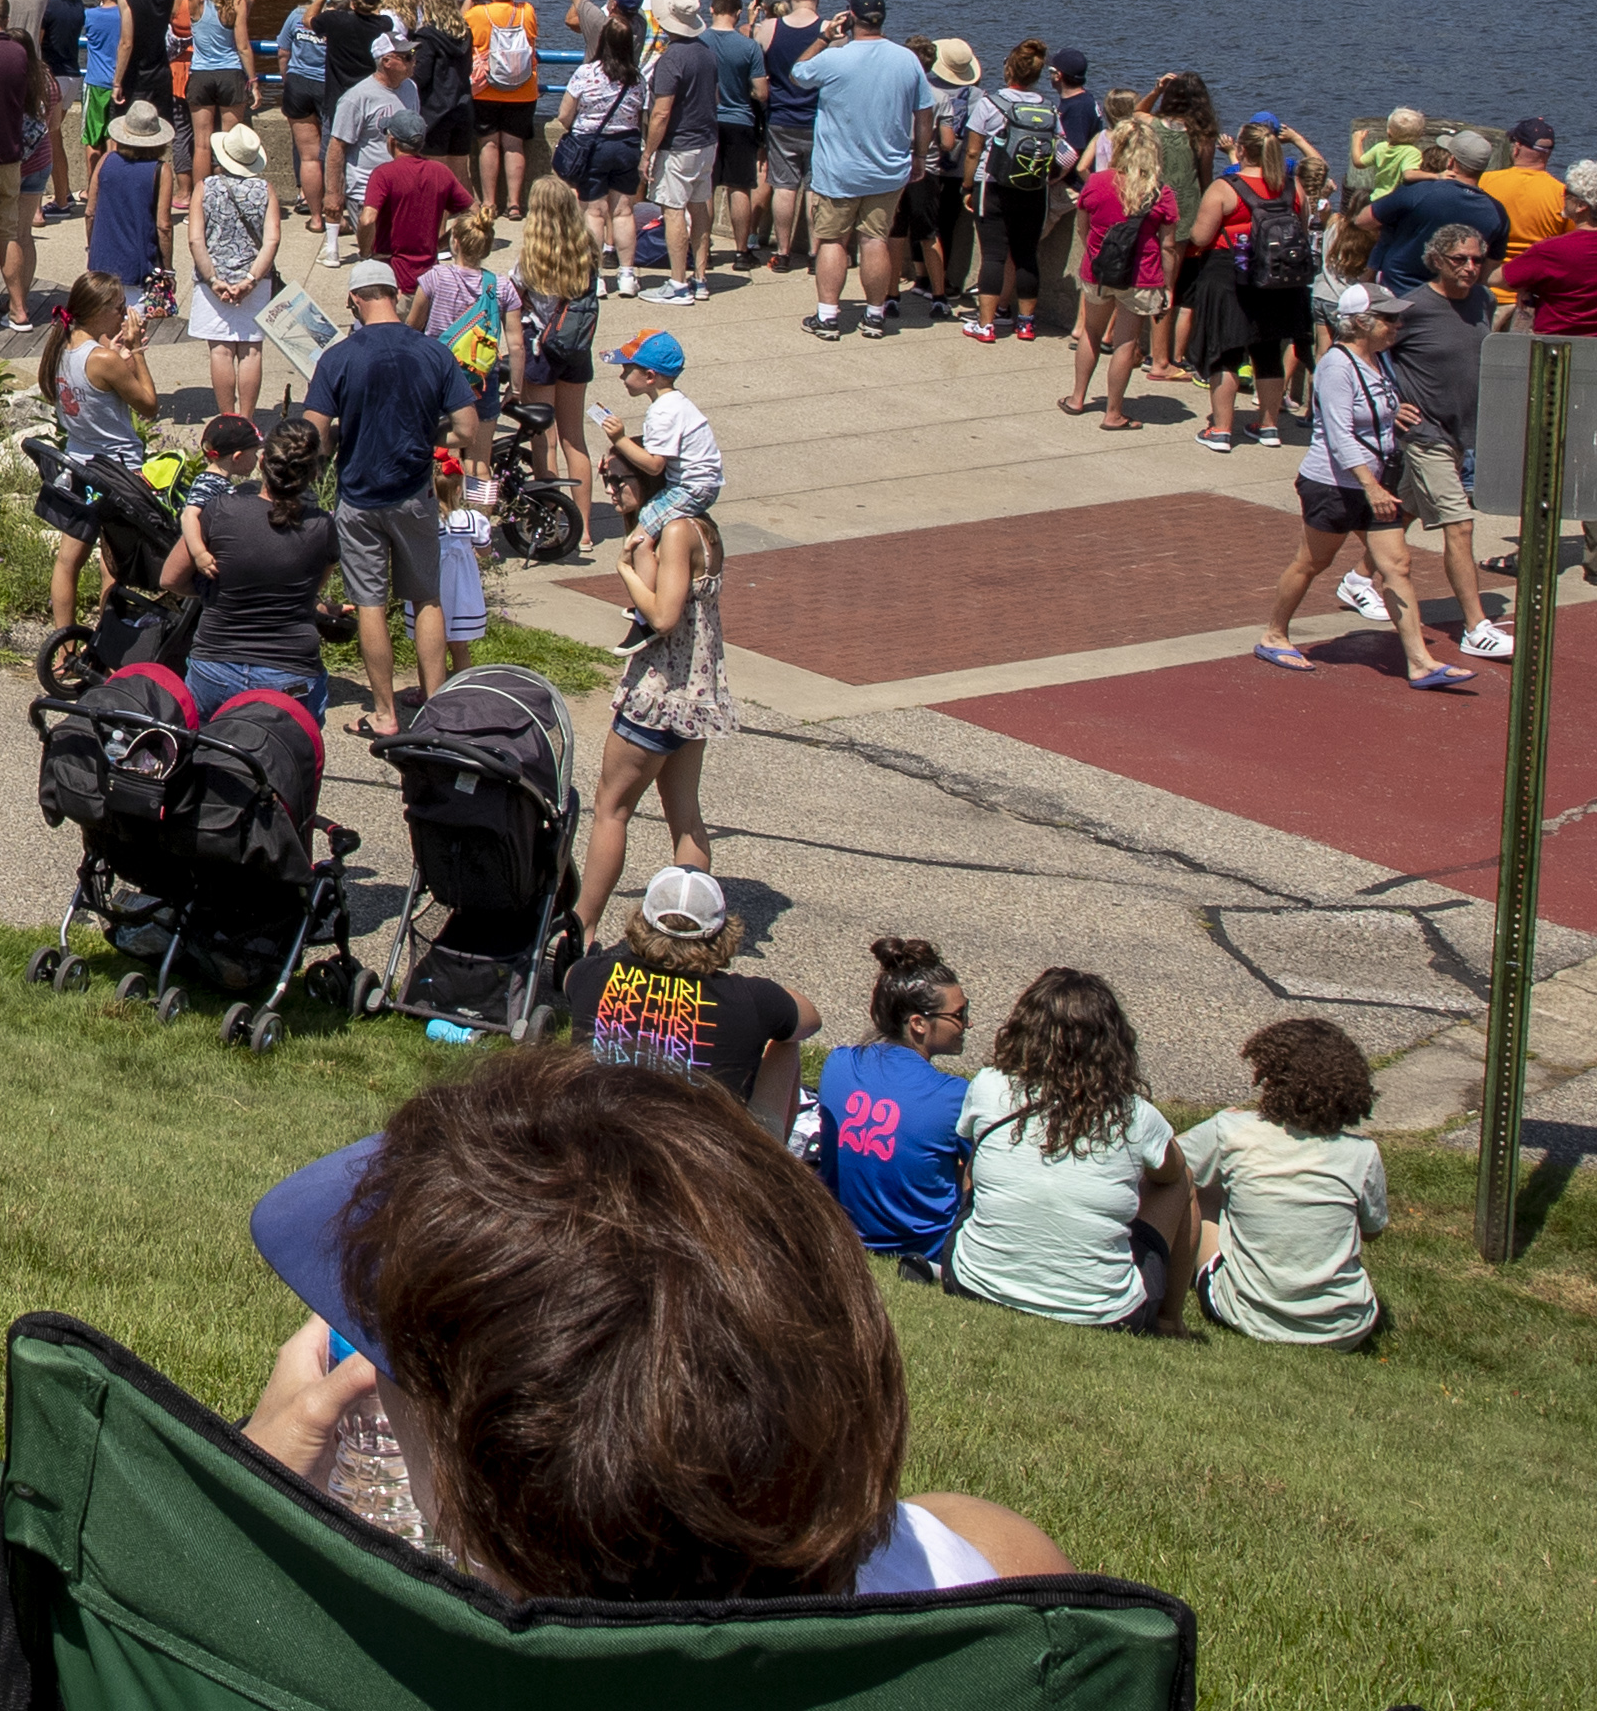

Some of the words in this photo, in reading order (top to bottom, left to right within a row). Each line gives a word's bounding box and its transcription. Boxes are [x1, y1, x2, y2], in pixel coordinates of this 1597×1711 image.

[609, 962, 647, 990] RIP
[647, 973, 718, 1006] CURL
[643, 993, 717, 1027] CURL
[838, 1090, 900, 1161] 22
